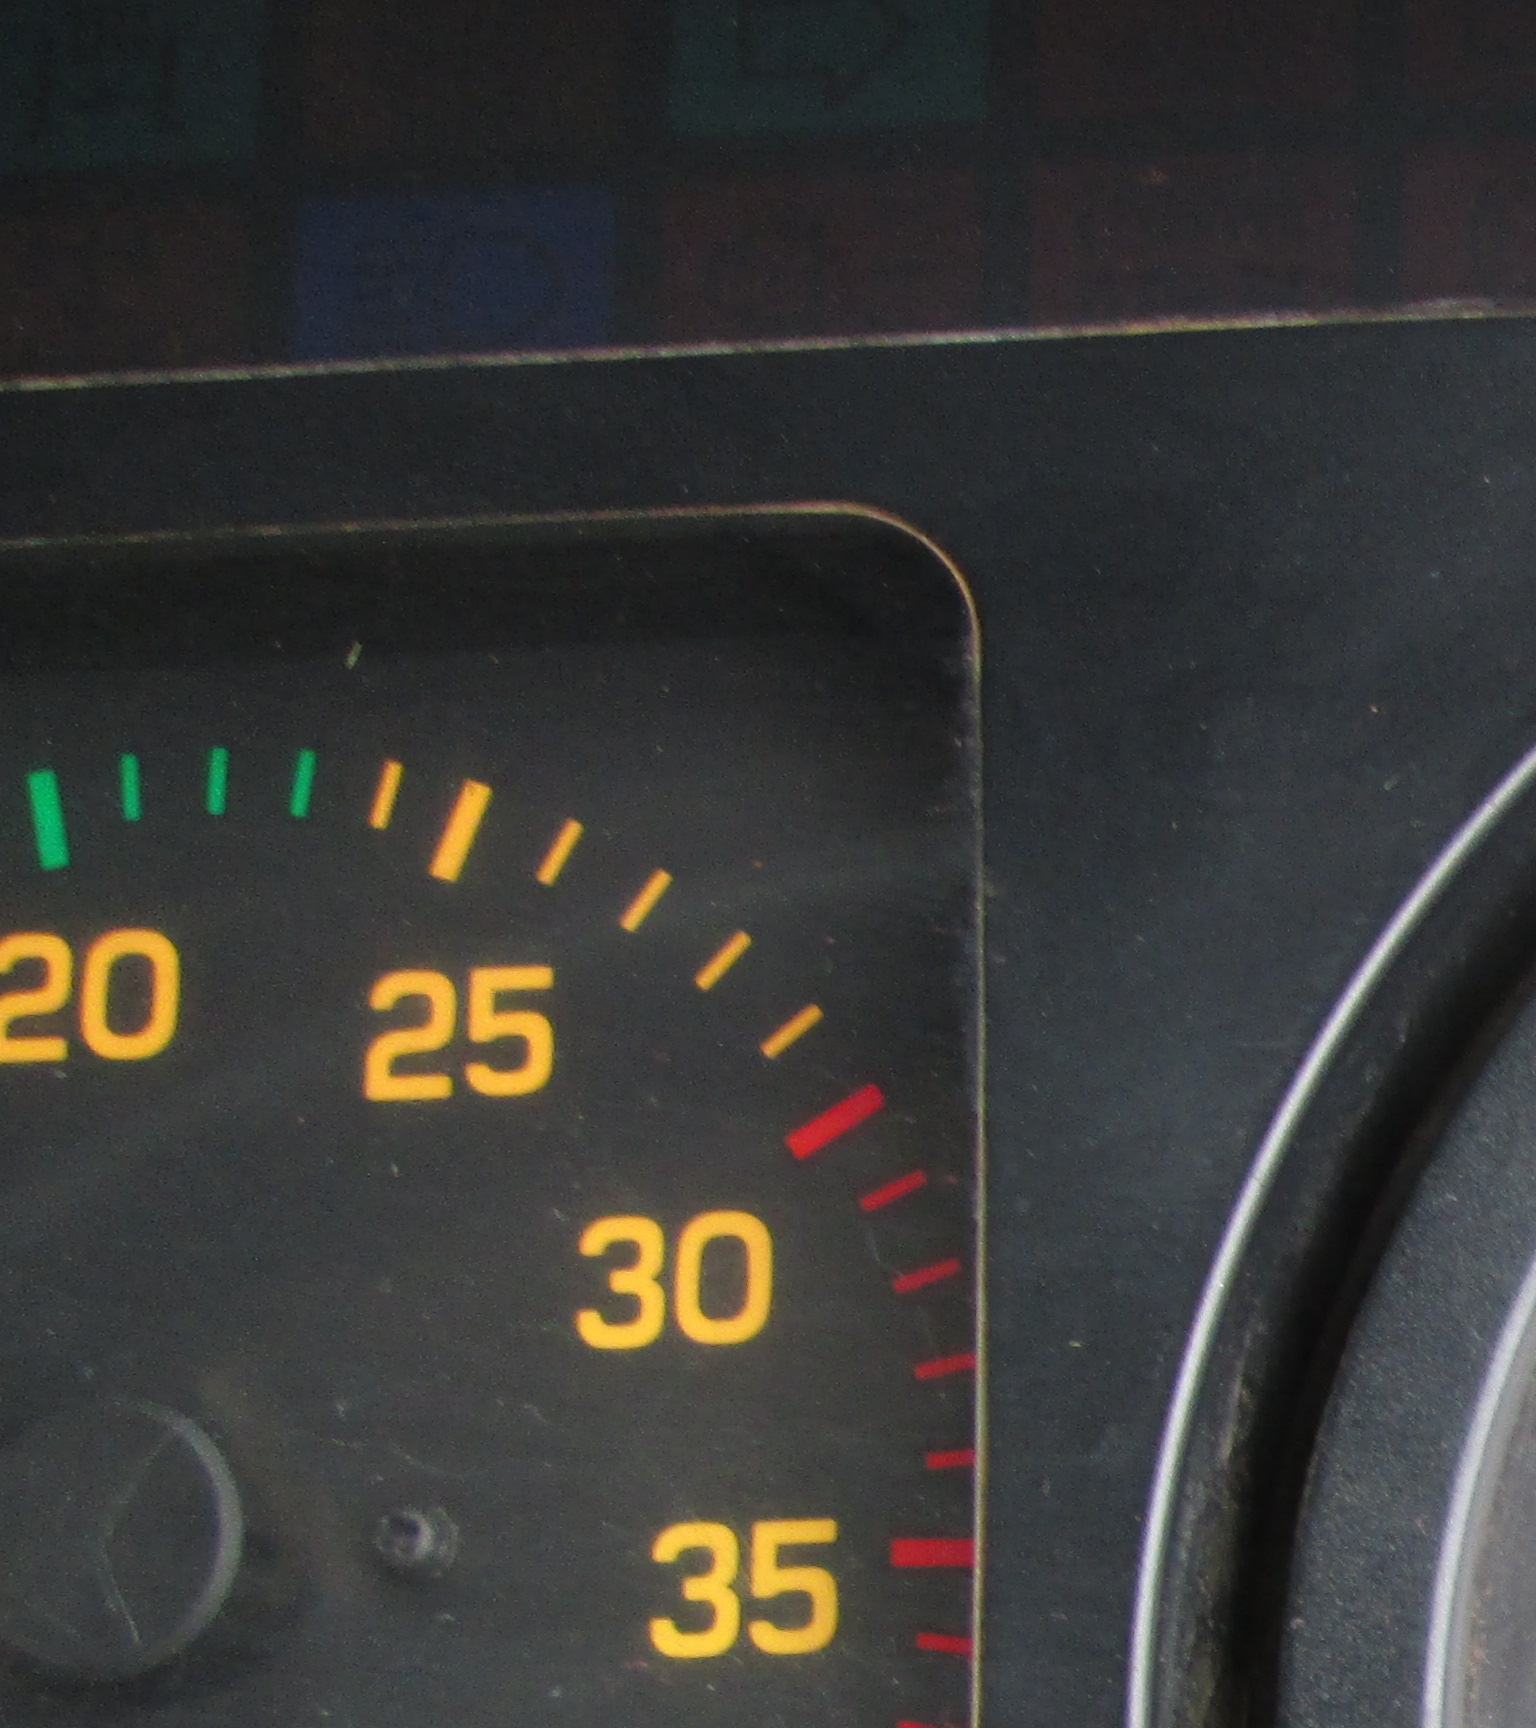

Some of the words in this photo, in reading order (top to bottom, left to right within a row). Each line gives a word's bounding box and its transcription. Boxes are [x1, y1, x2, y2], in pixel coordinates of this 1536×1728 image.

[0, 927, 181, 1064] 20
[362, 964, 556, 1102] 25
[573, 1208, 775, 1352] 30
[647, 1516, 841, 1662] 35
